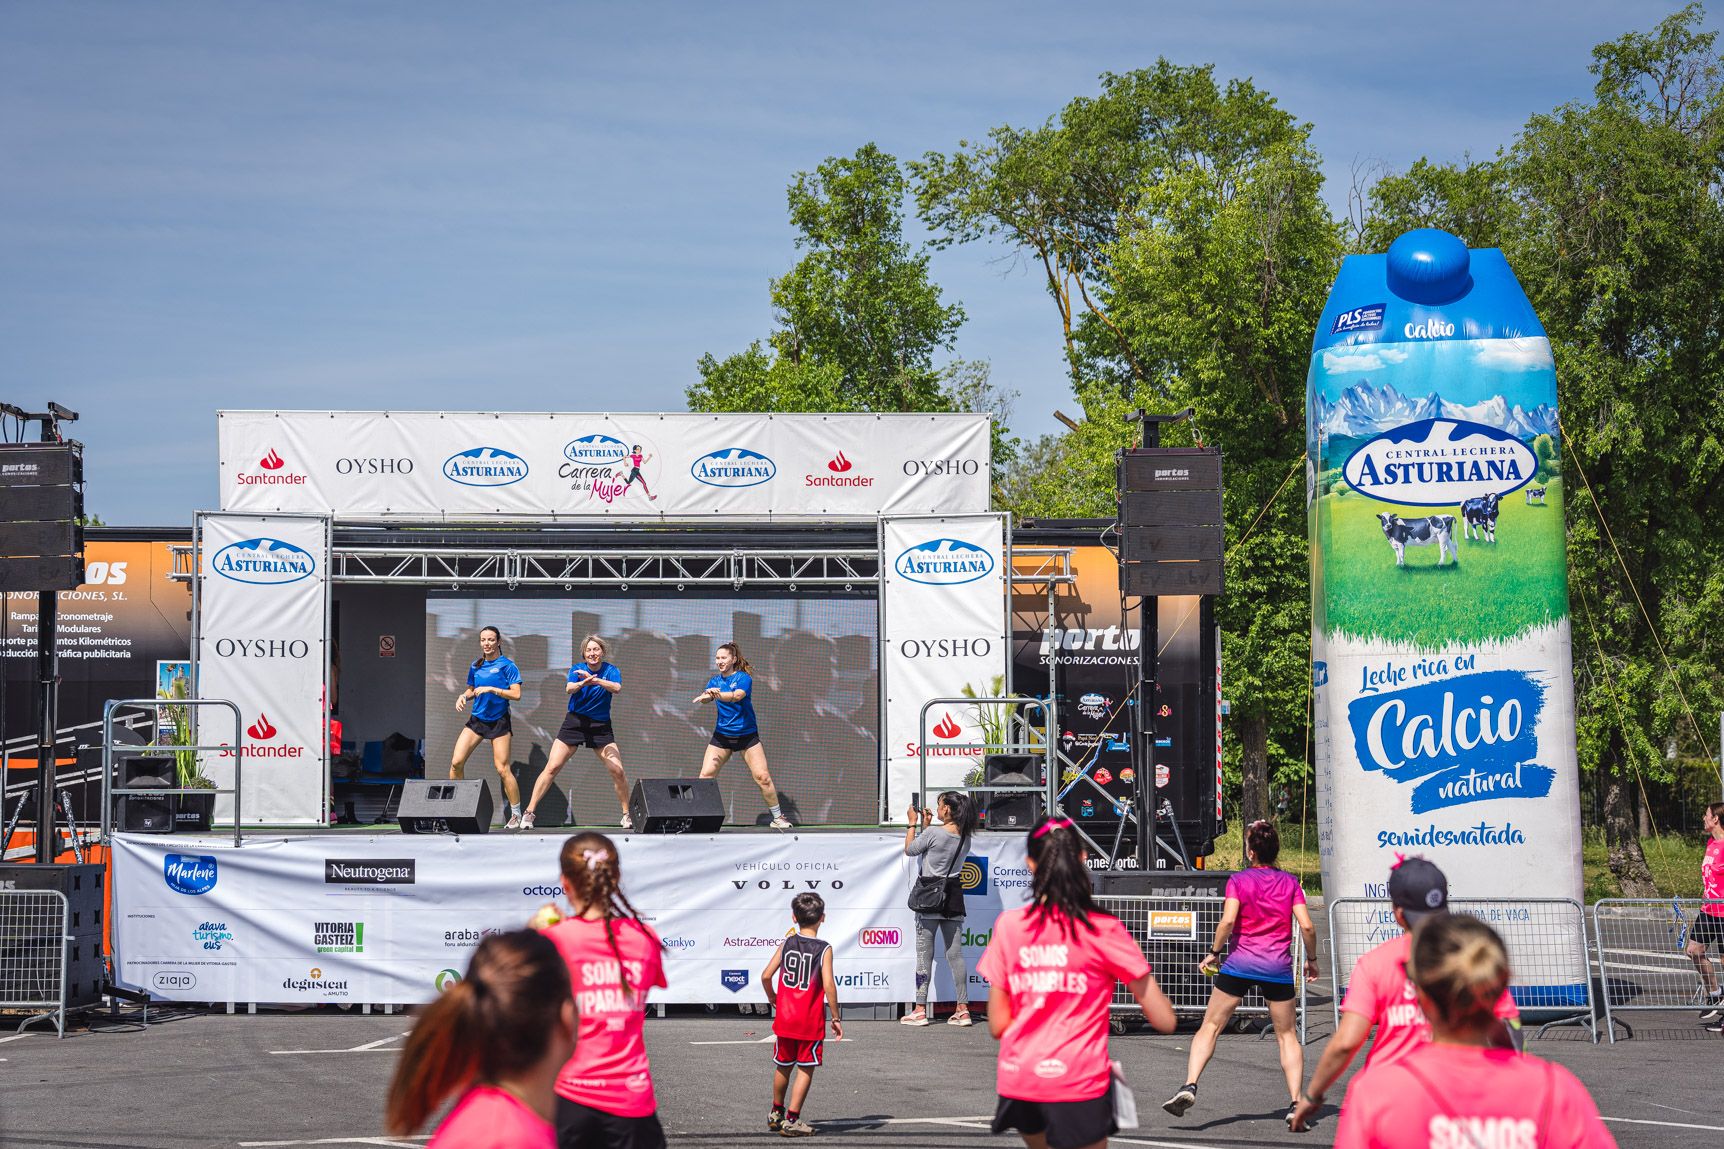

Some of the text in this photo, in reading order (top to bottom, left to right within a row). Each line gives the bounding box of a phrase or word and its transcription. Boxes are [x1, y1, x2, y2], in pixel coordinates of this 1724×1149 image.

[1338, 309, 1362, 327] PLS
[569, 445, 625, 458] ASTURIANA
[1386, 446, 1516, 459] CENTRAL LECHERA
[336, 458, 414, 475] OYSHO
[450, 461, 523, 477] ASTURIANA
[558, 462, 612, 479] Carrera
[698, 462, 770, 478] ASTURIANA
[903, 459, 979, 476] OYSHO
[1355, 453, 1524, 487] ASTURIANA
[237, 472, 307, 485] Santander
[805, 474, 875, 487] Santander
[571, 477, 632, 503] de la Mujer
[220, 553, 308, 574] ASTURIANA
[903, 556, 987, 574] ASTURIANA
[11, 612, 39, 622] Rampa
[57, 624, 101, 633] Modulares
[79, 637, 131, 645] Kilométricos
[1039, 625, 1141, 655] porto
[57, 649, 82, 658] ráfica
[83, 649, 131, 659] publicitaria
[216, 638, 309, 659] OYSHO
[901, 637, 991, 658] OYSHO
[1359, 654, 1476, 694] Leche rica en
[1366, 691, 1523, 770] Calcio
[1439, 762, 1523, 800] natural
[1377, 821, 1526, 849] semidesnatada
[167, 862, 215, 884] Marlene
[330, 863, 410, 882] Neutrogena
[735, 861, 840, 871] VEHÍCULO OFICIAL
[993, 866, 1033, 876] Correos
[732, 880, 844, 890] VOLVO
[993, 877, 1032, 889] Express
[523, 885, 566, 898] octop
[1490, 909, 1501, 921] DE
[1506, 908, 1530, 921] VACA
[314, 922, 354, 934] VITORIA
[444, 928, 479, 940] araba
[314, 934, 354, 946] GASTEIZ
[662, 937, 696, 950] Sankyo
[862, 930, 899, 945] COSMO
[334, 945, 354, 953] capital
[782, 949, 813, 991] 91
[159, 976, 190, 988] ziaja
[282, 978, 348, 992] degusteat
[835, 971, 889, 986] variTek
[969, 975, 979, 984] EL
